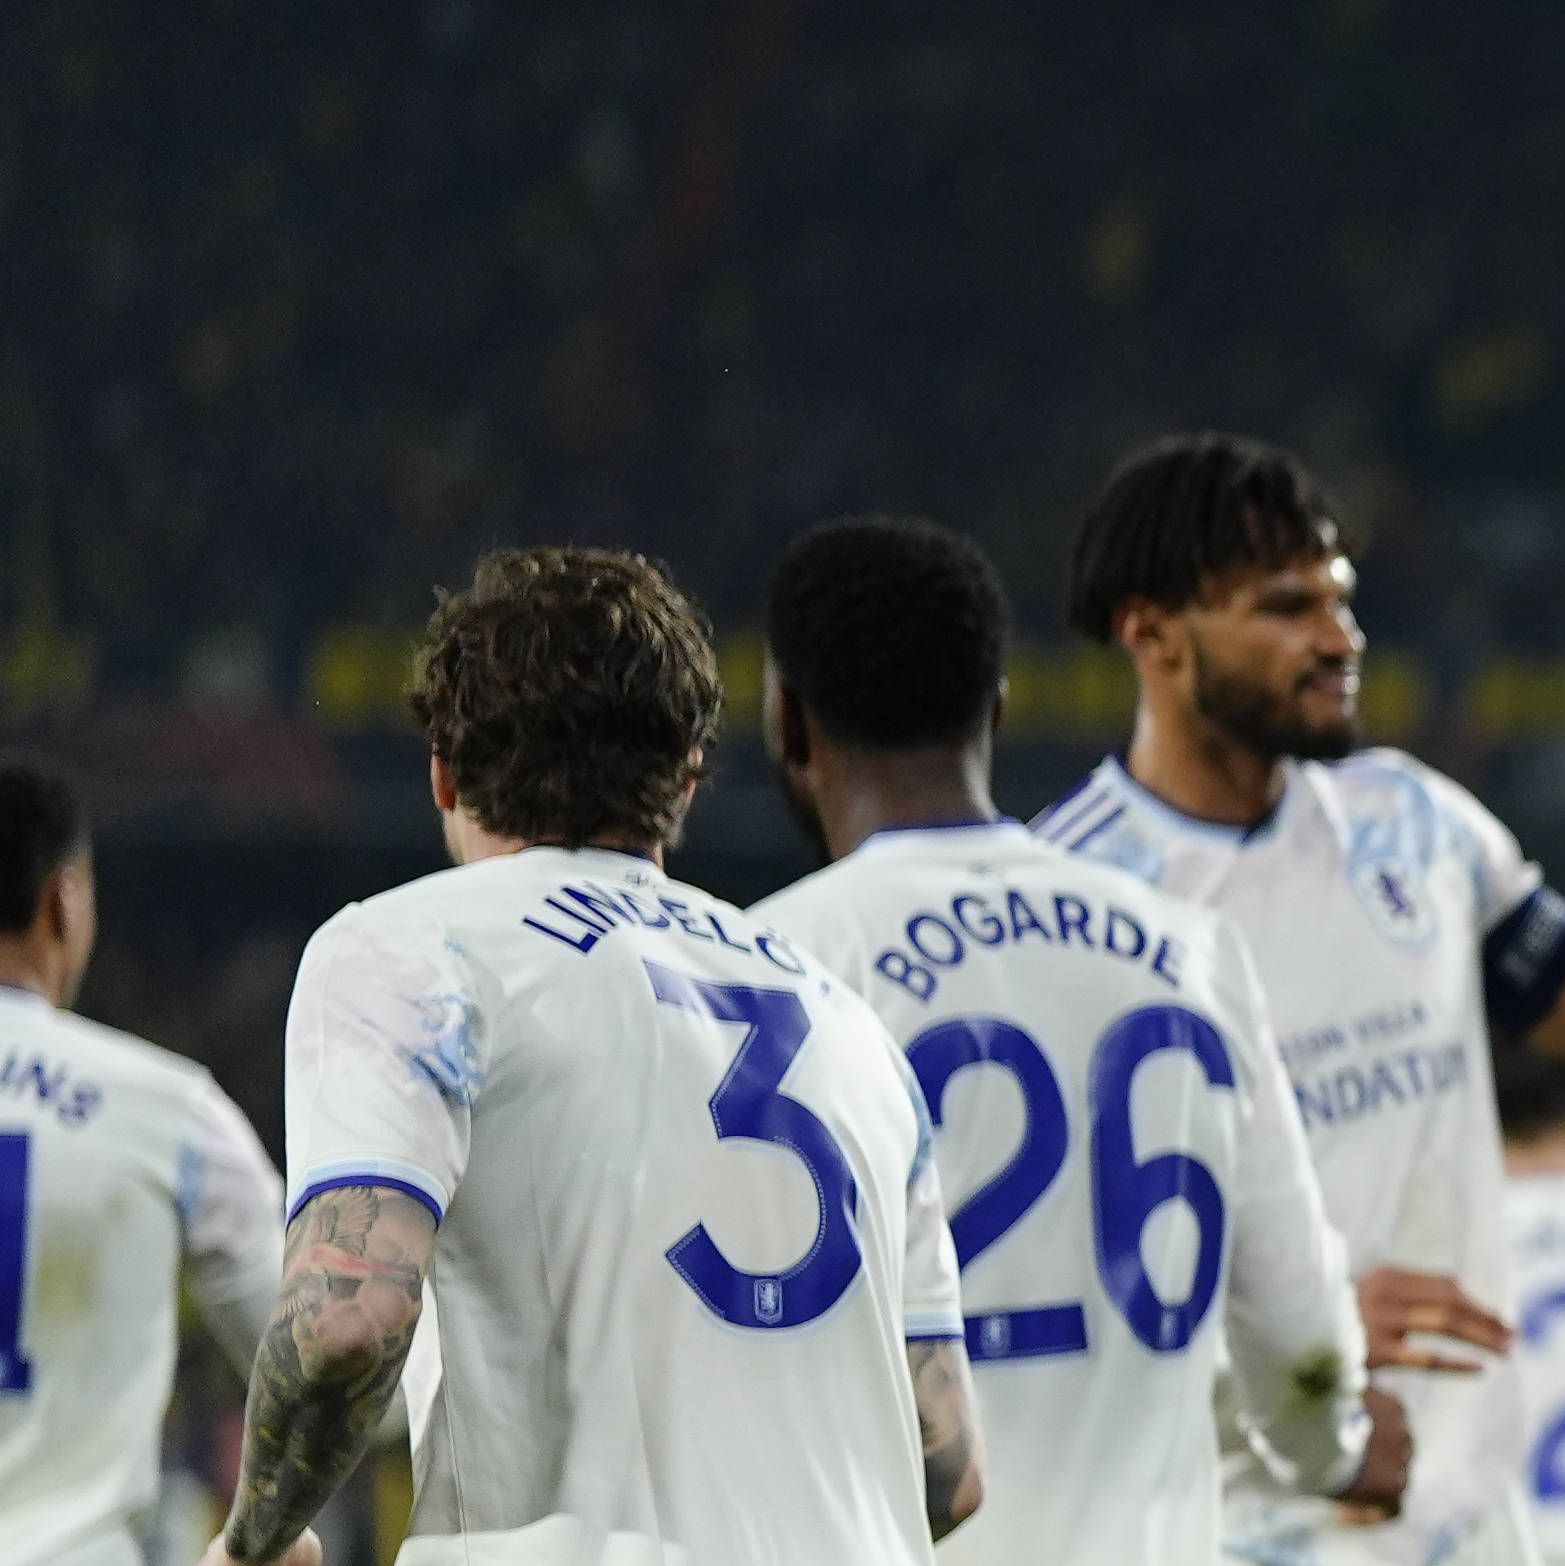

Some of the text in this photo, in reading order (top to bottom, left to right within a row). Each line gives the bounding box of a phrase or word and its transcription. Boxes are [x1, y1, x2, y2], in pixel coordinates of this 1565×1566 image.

[523, 878, 832, 996] LINDELÖ
[875, 889, 1190, 1001] BOGARDE
[643, 955, 863, 1331] 3
[905, 1004, 1238, 1362] 26
